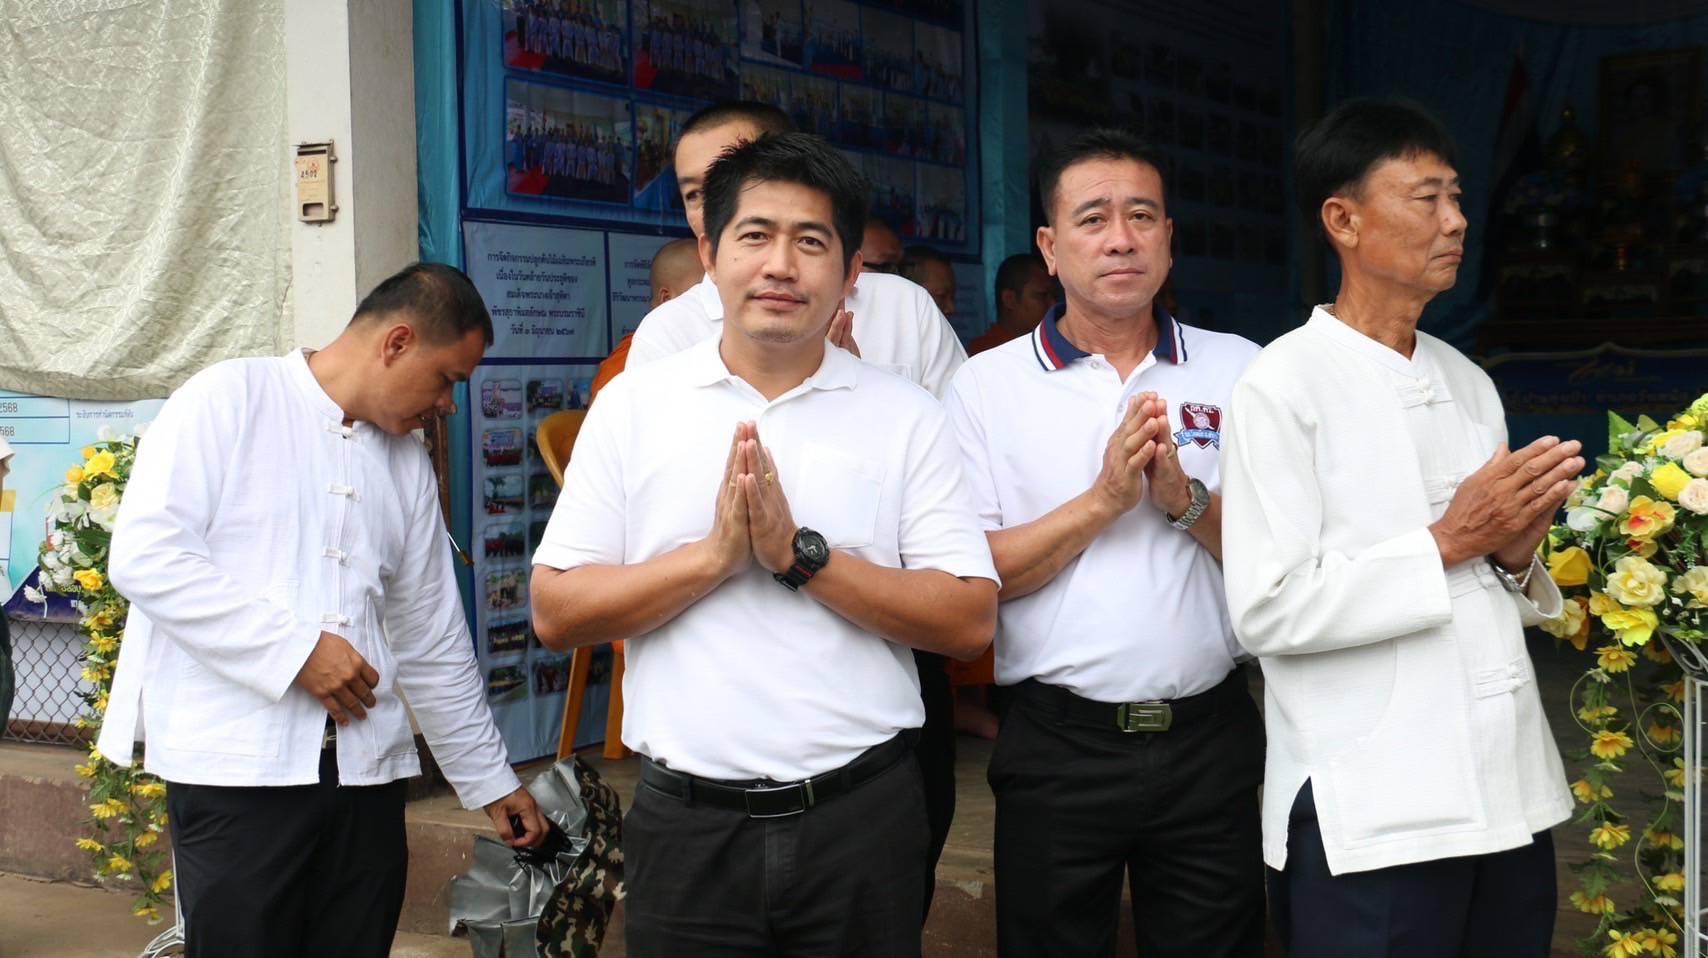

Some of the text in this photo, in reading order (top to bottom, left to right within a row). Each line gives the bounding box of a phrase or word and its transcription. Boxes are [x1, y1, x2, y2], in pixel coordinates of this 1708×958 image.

[506, 288, 571, 303] สมเด็จพระนางเจ้าสุทิดา
[549, 307, 585, 319] พระบรมราชินี
[510, 322, 524, 335] วันที่
[531, 323, 555, 339] มิถุนายน
